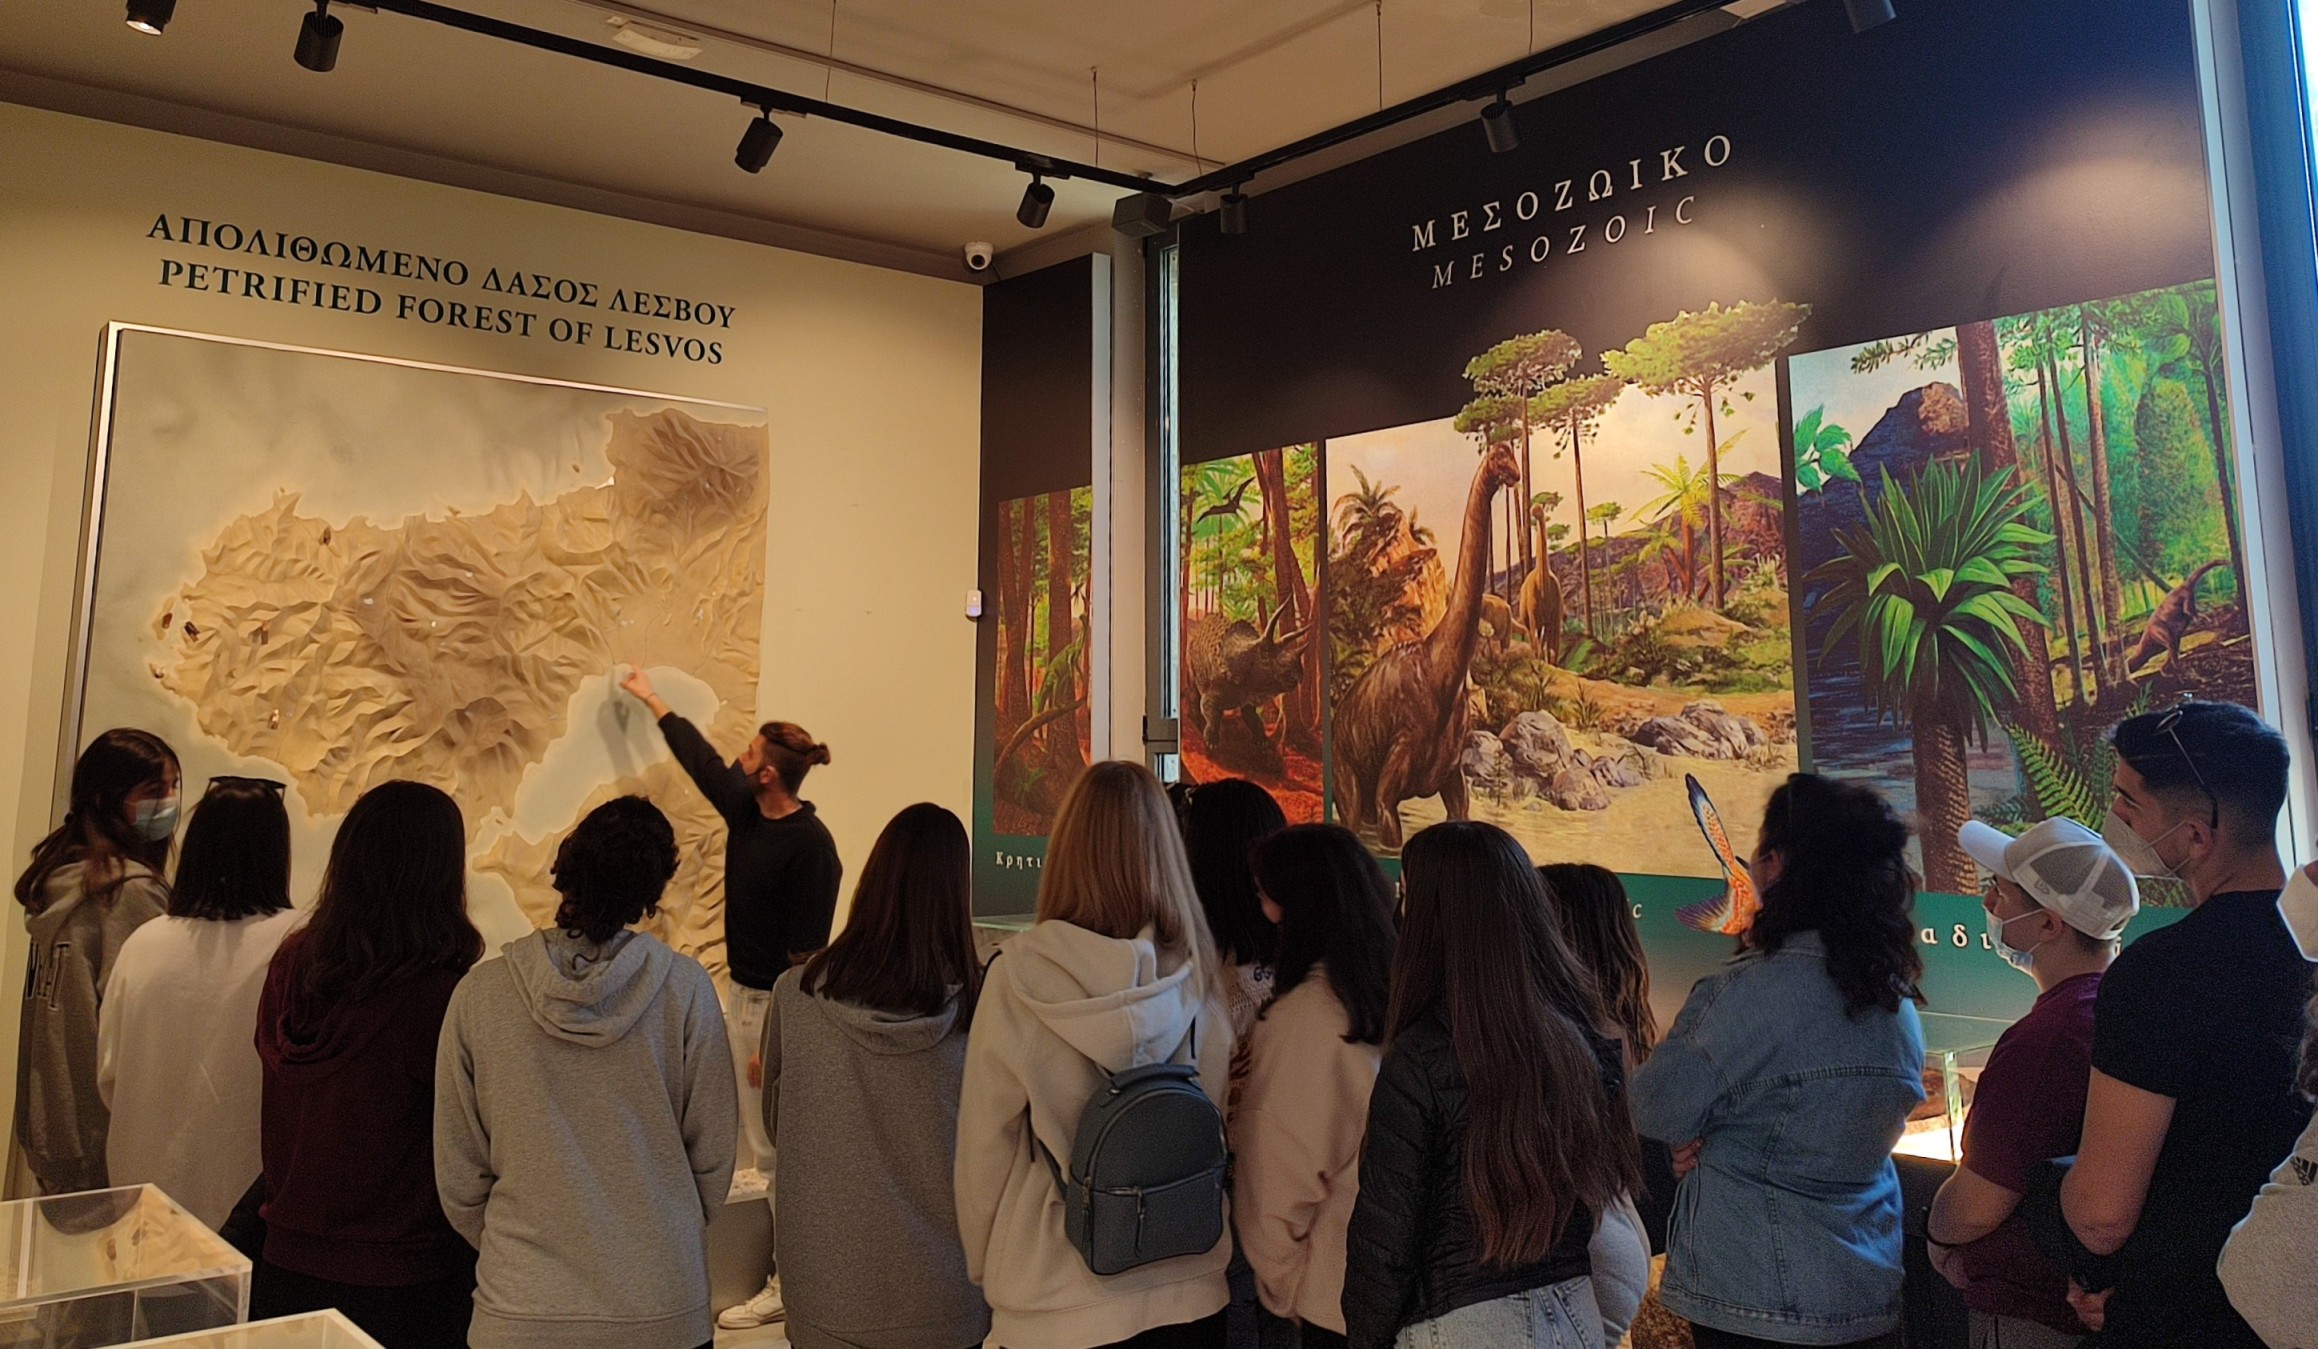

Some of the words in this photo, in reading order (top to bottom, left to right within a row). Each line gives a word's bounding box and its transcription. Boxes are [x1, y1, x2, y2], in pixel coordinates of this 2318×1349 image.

[1411, 135, 1731, 252] ΜΕΣΟΖΩΙΚΟ
[1431, 195, 1695, 289] MESOZOIC
[145, 213, 469, 286] ΑΠΟΛΙΘΩΜΕΝΟ
[481, 267, 598, 308] ΔΑΣΟΣ
[608, 288, 736, 329] ΛΕΣΒΟΥ
[158, 258, 382, 315] PETRIFIED
[395, 293, 538, 337] FOREST
[548, 317, 593, 345] OF
[603, 325, 723, 365] LESVOS
[995, 851, 1043, 870] Κρητι
